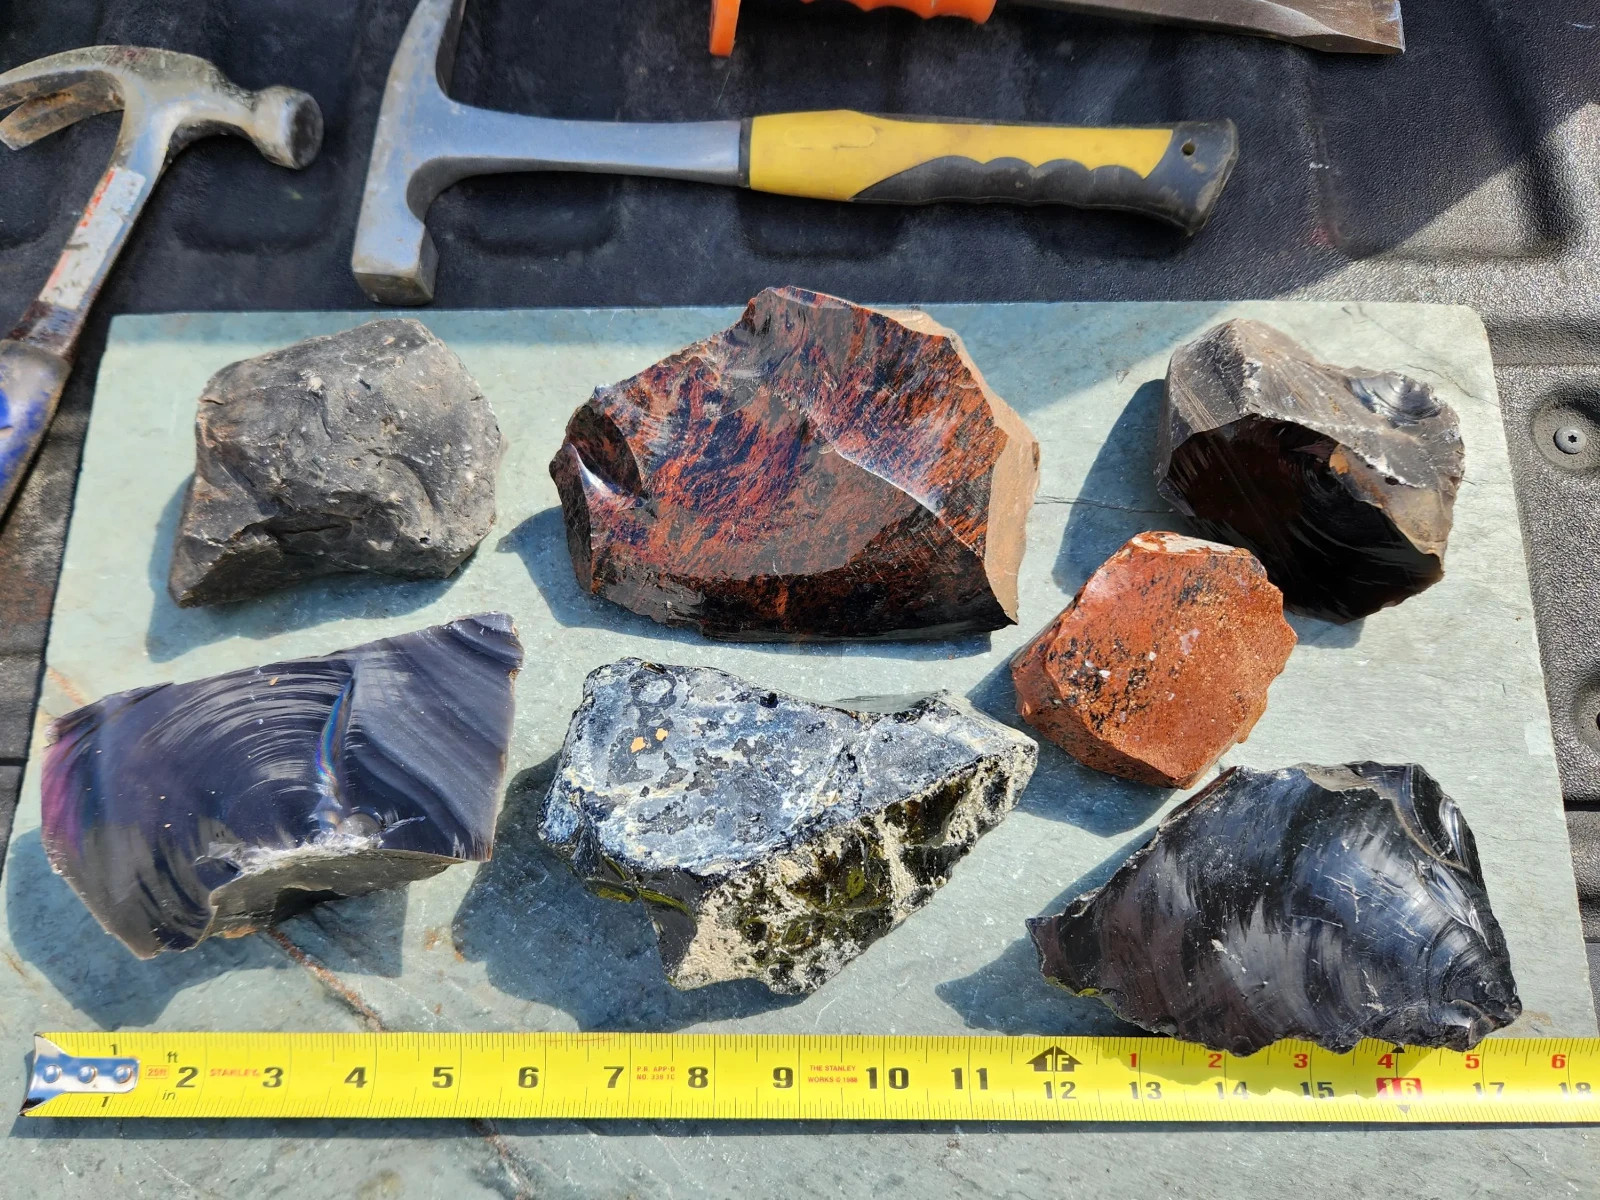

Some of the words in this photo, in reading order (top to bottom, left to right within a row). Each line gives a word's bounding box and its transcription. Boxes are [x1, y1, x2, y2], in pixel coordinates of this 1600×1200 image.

[110, 1043, 118, 1056] 1
[167, 1051, 178, 1063] ft
[1128, 1053, 1138, 1068] 1
[1208, 1053, 1223, 1069] 2
[1293, 1053, 1309, 1069] 3
[1377, 1053, 1394, 1069] 4
[1465, 1053, 1480, 1069] 5
[1551, 1053, 1566, 1069] 6
[175, 1066, 199, 1088] 2
[263, 1066, 284, 1089] 3
[344, 1066, 368, 1089] 4
[431, 1066, 454, 1089] 5
[518, 1066, 540, 1089] 6
[603, 1066, 625, 1089] 7
[687, 1066, 709, 1089] 8
[772, 1066, 794, 1089] 9
[865, 1066, 909, 1090] 10
[950, 1067, 989, 1090] 11
[162, 1090, 176, 1101] in
[1043, 1080, 1076, 1100] 12
[1128, 1080, 1162, 1100] 13
[1214, 1081, 1248, 1100] 14
[1300, 1081, 1335, 1100] 15
[1385, 1079, 1416, 1099] 16
[1473, 1082, 1505, 1100] 17
[1559, 1082, 1592, 1100] 18
[100, 1095, 110, 1108] 1
